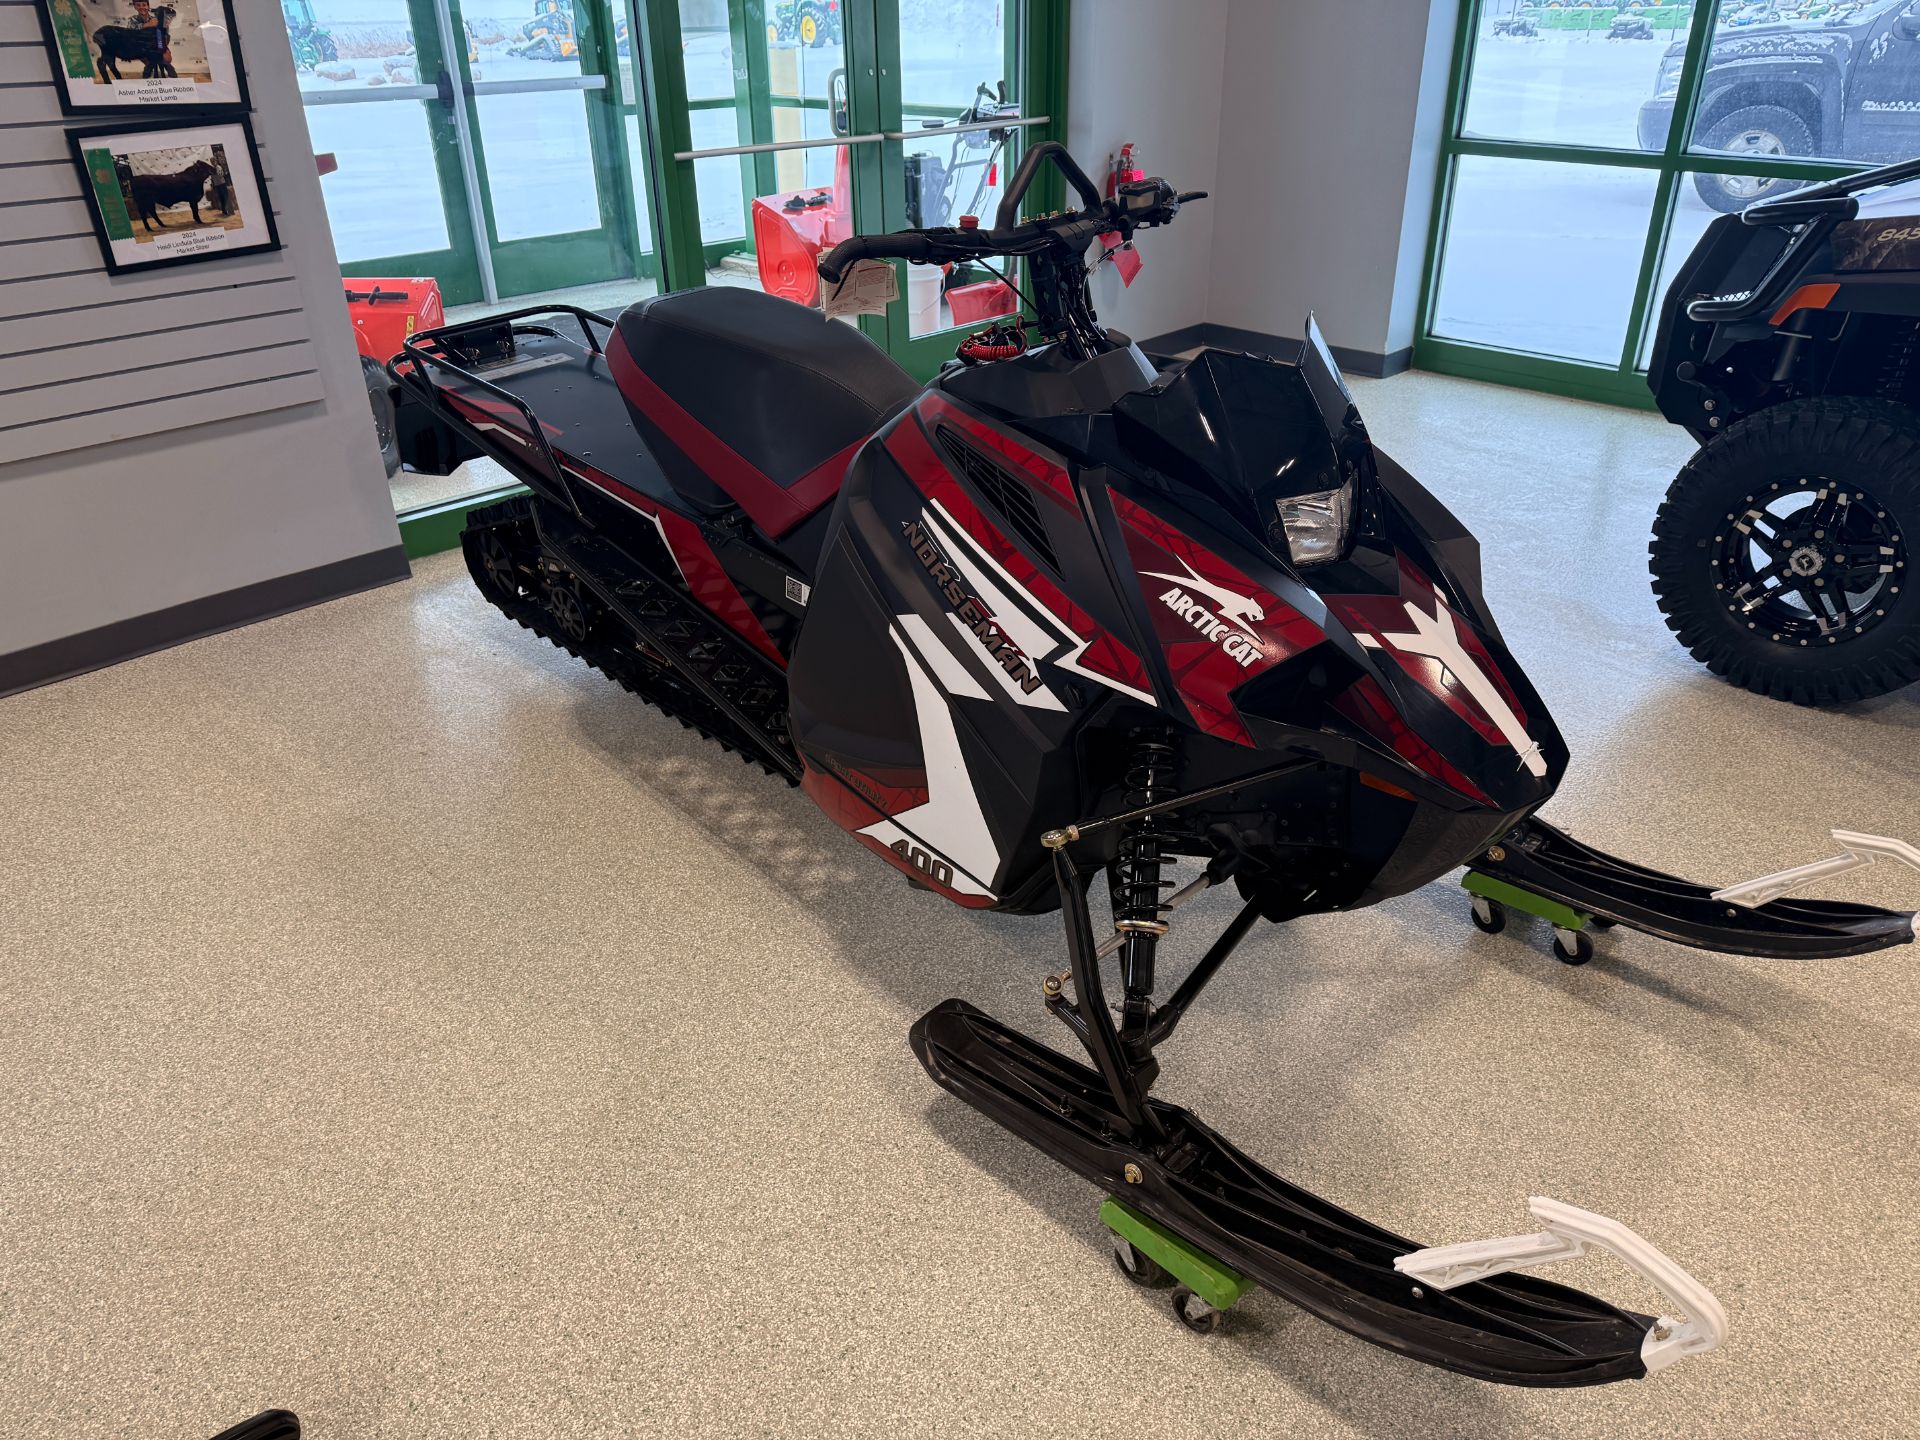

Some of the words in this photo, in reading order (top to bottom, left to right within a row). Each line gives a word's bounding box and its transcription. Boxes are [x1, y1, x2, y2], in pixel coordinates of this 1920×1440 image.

[182, 231, 197, 239] 2024
[901, 521, 1043, 695] NORSEMAN
[1159, 587, 1230, 643] ARCTIC
[1222, 633, 1264, 668] CAT
[890, 838, 953, 888] 400
